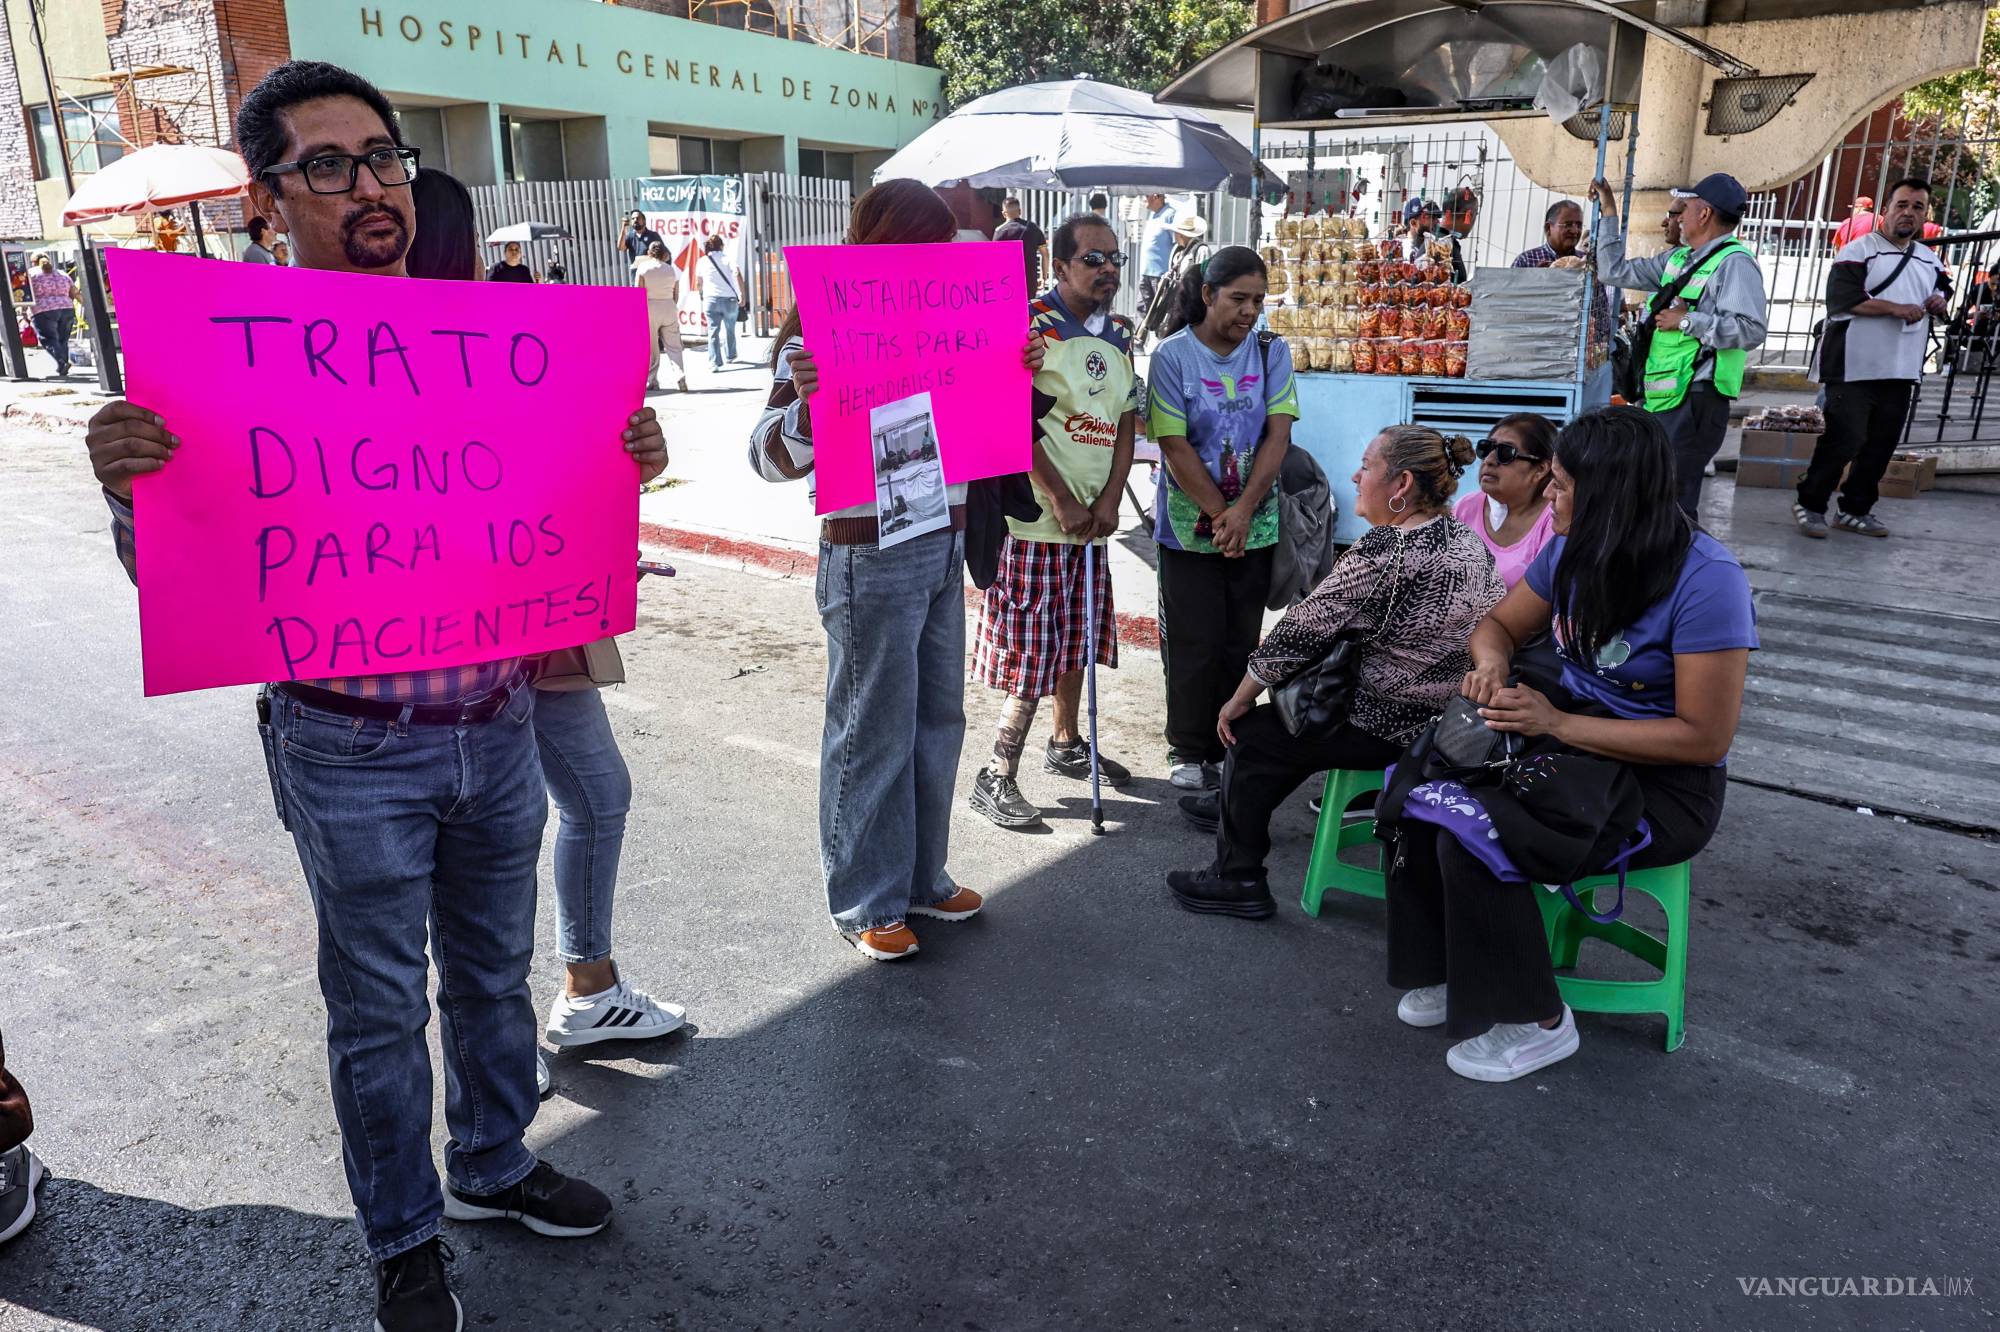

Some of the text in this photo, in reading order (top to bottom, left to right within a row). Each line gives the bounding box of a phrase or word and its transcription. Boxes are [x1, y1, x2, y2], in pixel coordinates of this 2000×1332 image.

[360, 7, 588, 68] HOSPITAL
[616, 49, 762, 94] GENERAL
[782, 76, 812, 101] DE
[829, 84, 896, 113] ZONA
[932, 102, 940, 119] 2
[641, 186, 665, 201] HGZ
[712, 187, 720, 202] 2
[209, 315, 549, 397] TRATO
[831, 328, 989, 368] APTAS PARA
[1217, 396, 1253, 414] PACO
[248, 426, 503, 499] DIGNO
[254, 522, 442, 603] PARA
[265, 574, 612, 680] PACIENTES!
